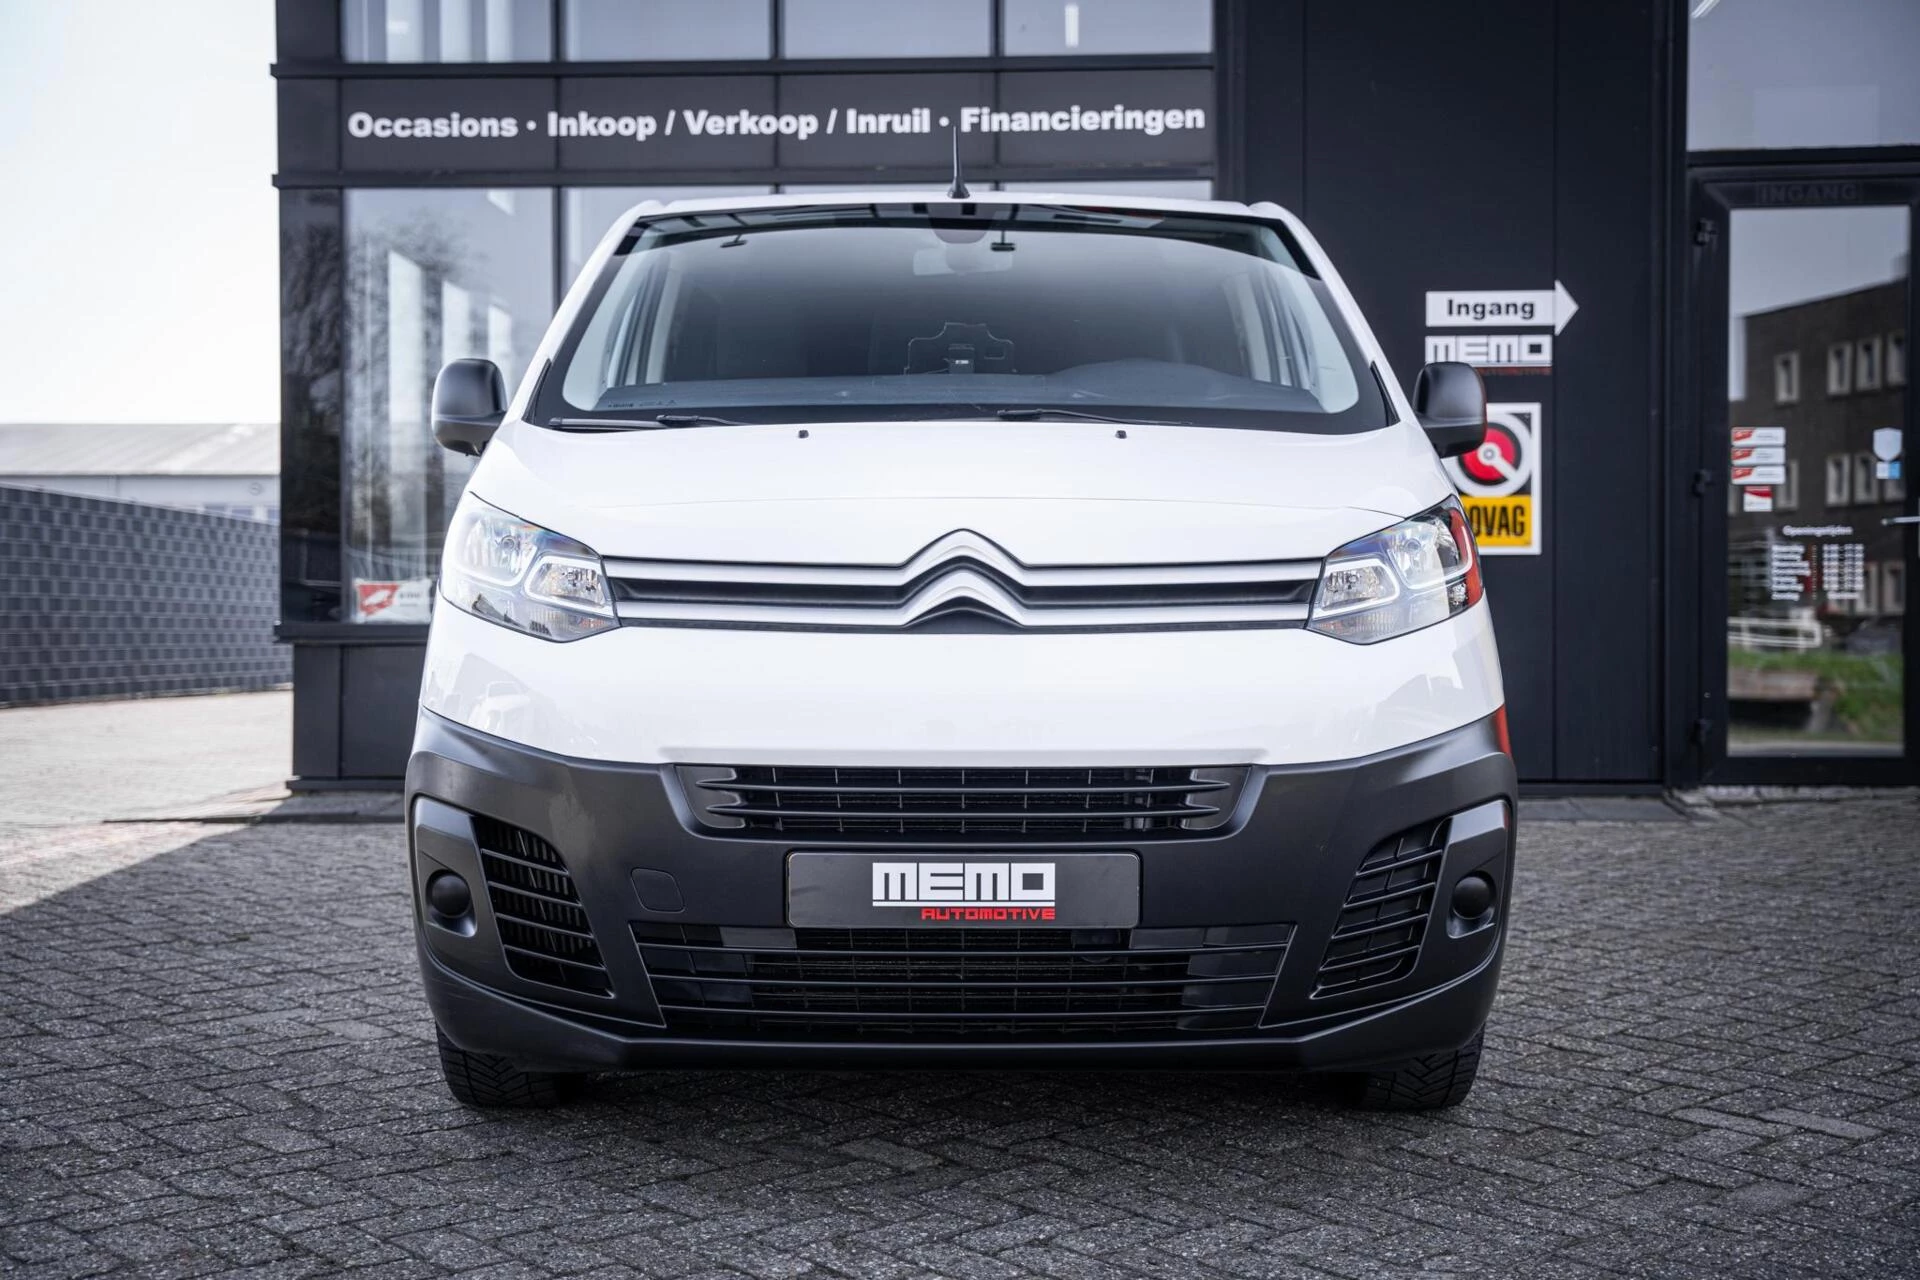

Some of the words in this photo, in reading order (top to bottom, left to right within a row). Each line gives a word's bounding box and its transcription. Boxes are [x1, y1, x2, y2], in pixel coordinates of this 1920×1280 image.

[348, 111, 519, 138] Occasions
[547, 110, 658, 142] Inkoop
[682, 109, 819, 141] Verkoop
[846, 107, 931, 134] Inruil
[960, 104, 1206, 136] Financieringen
[1759, 183, 1858, 203] INGANG
[1447, 298, 1535, 320] Ingang
[1425, 335, 1552, 364] MEMO
[1465, 504, 1526, 537] OVAG
[873, 863, 1056, 900] MEMO
[921, 907, 1056, 921] AUTOMOTIVE
